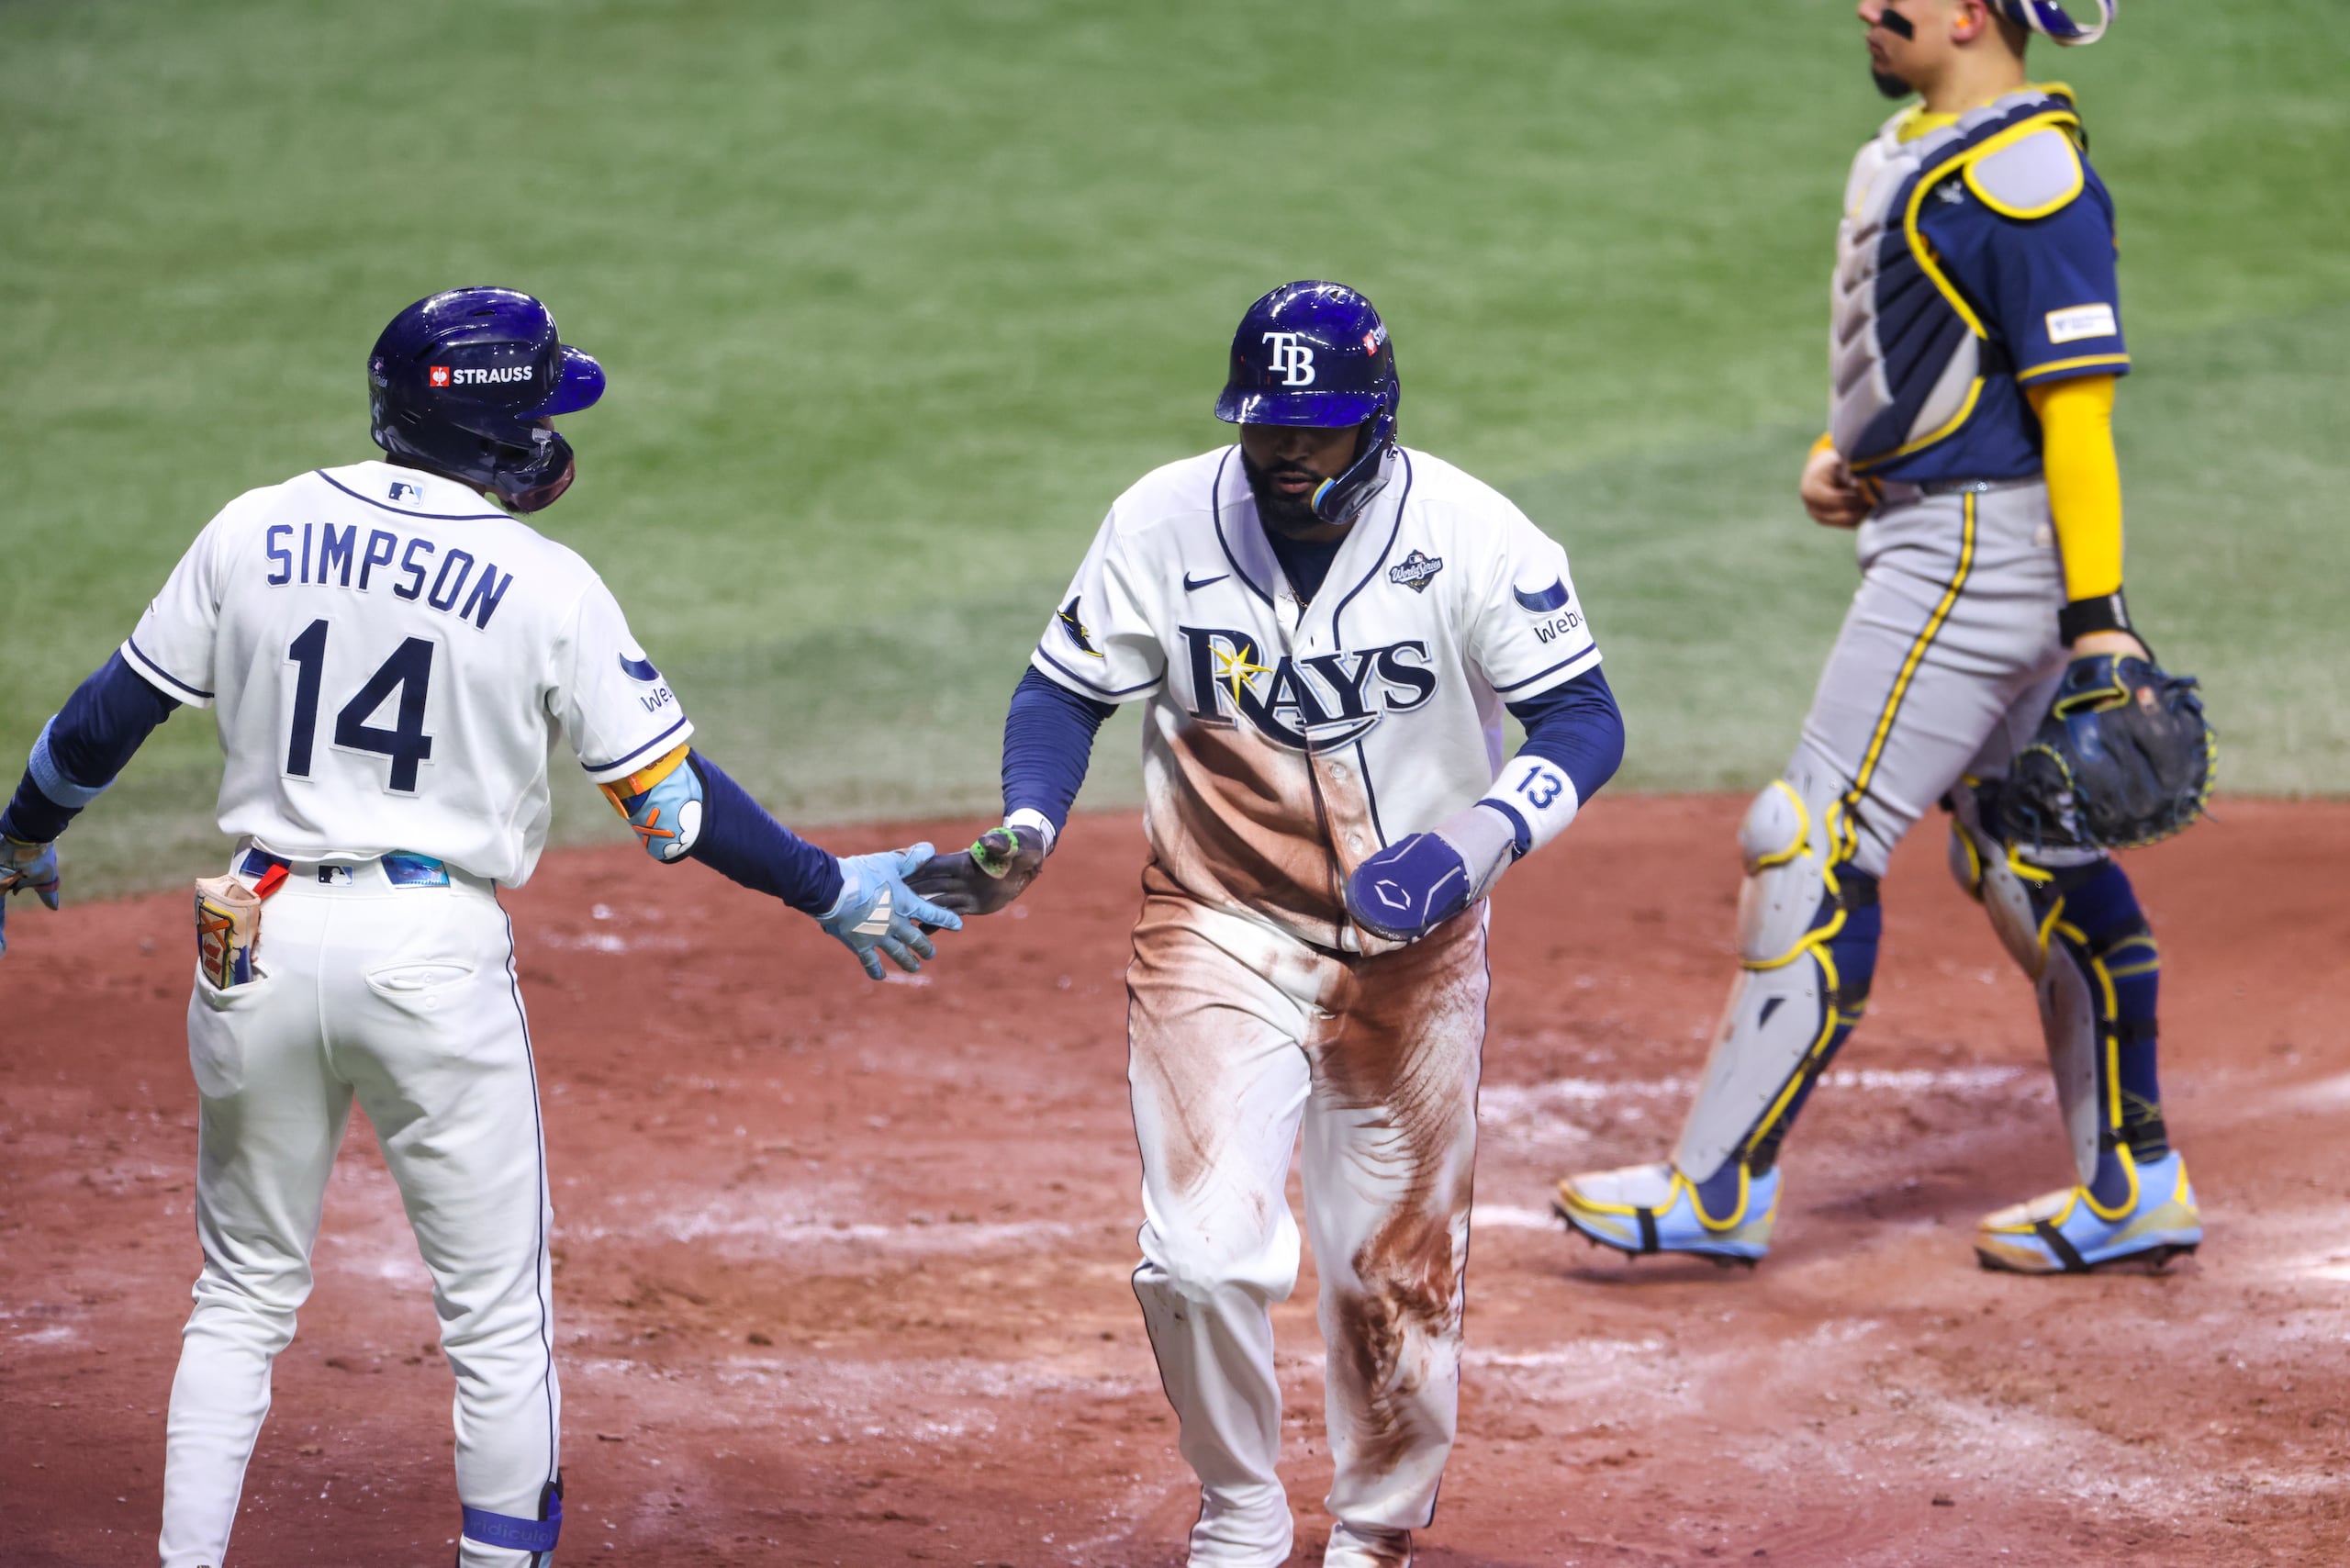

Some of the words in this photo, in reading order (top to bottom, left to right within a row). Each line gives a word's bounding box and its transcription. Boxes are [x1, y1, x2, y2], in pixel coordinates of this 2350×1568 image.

[453, 365, 533, 385] STRAUSS
[1261, 331, 1316, 386] TB
[265, 521, 514, 631] SIMPSON
[285, 617, 437, 795] 14
[1178, 624, 1439, 755] RAYS
[1516, 766, 1562, 810] 13
